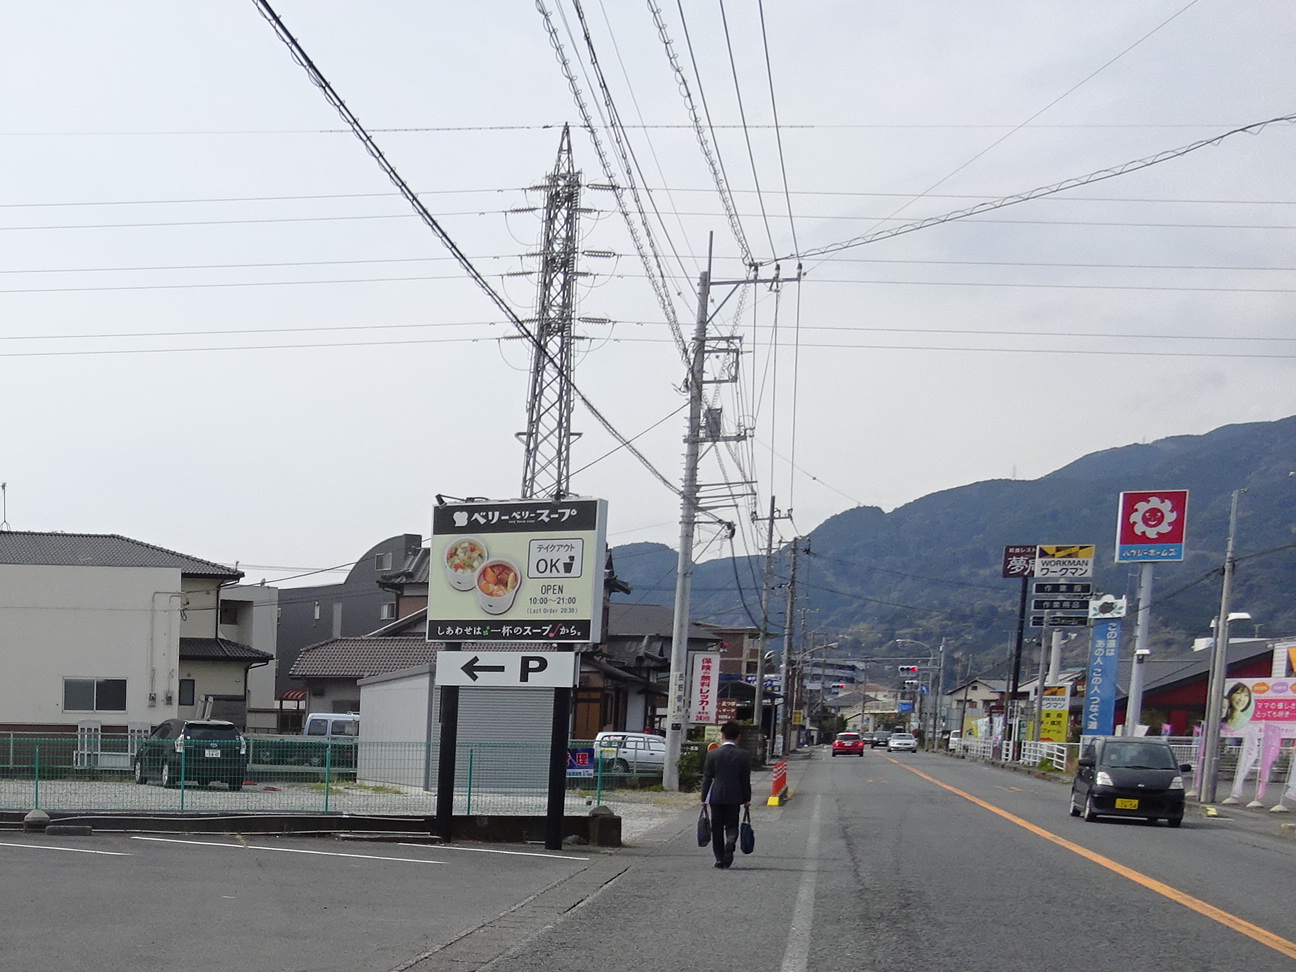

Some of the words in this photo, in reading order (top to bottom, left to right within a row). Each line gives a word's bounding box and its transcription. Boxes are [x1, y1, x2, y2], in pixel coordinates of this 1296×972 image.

[537, 543, 575, 552] テイクアウト
[536, 558, 561, 574] OK
[1040, 567, 1088, 576] ワークマン
[540, 584, 564, 595] OPEN
[519, 655, 548, 683] P
